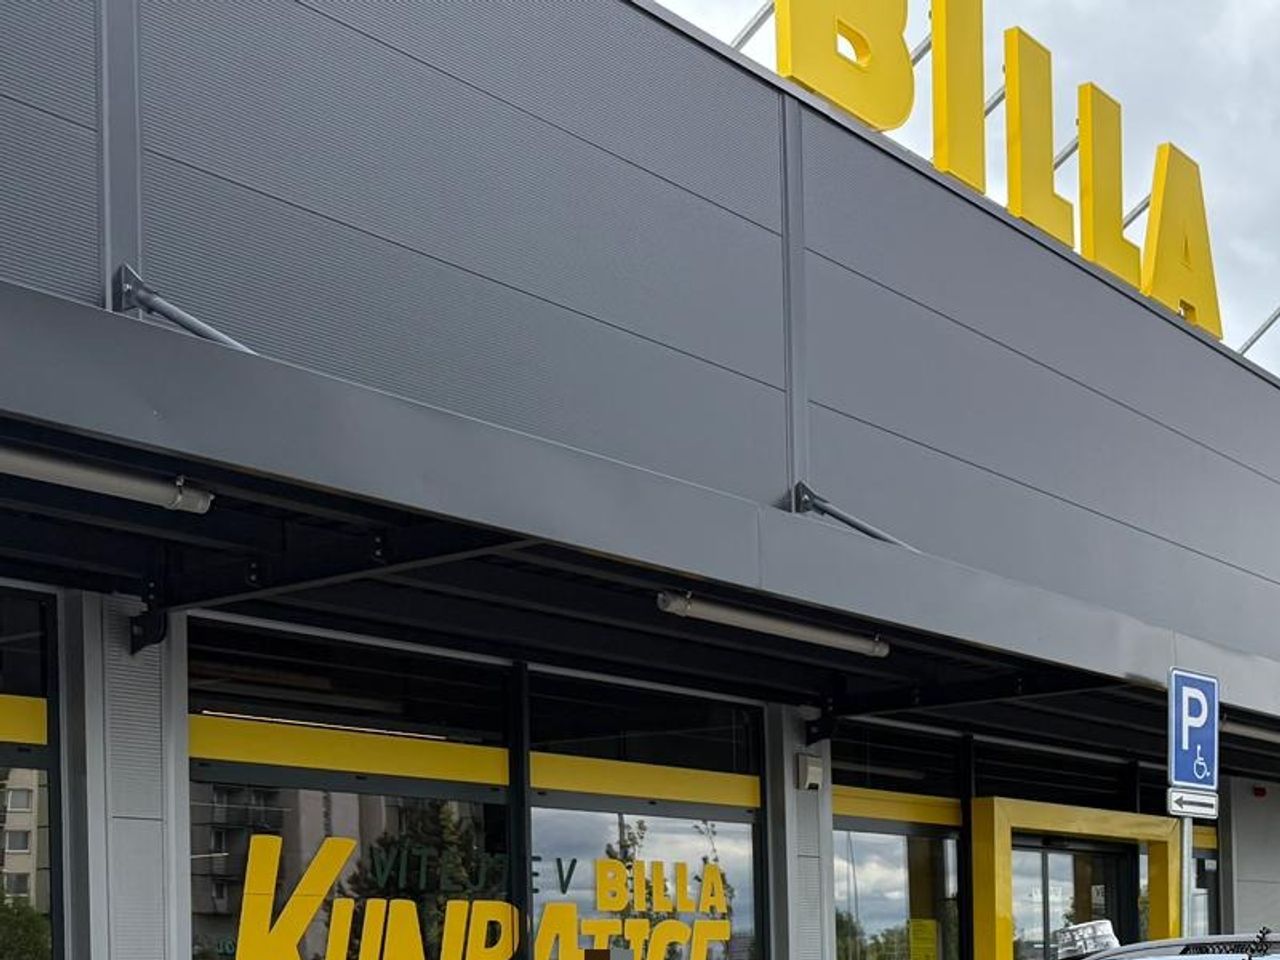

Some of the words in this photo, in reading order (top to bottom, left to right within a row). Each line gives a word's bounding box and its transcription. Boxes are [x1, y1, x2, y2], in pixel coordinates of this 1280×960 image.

[1182, 686, 1208, 751] P
[555, 857, 577, 894] V
[595, 858, 728, 913] BILLA
